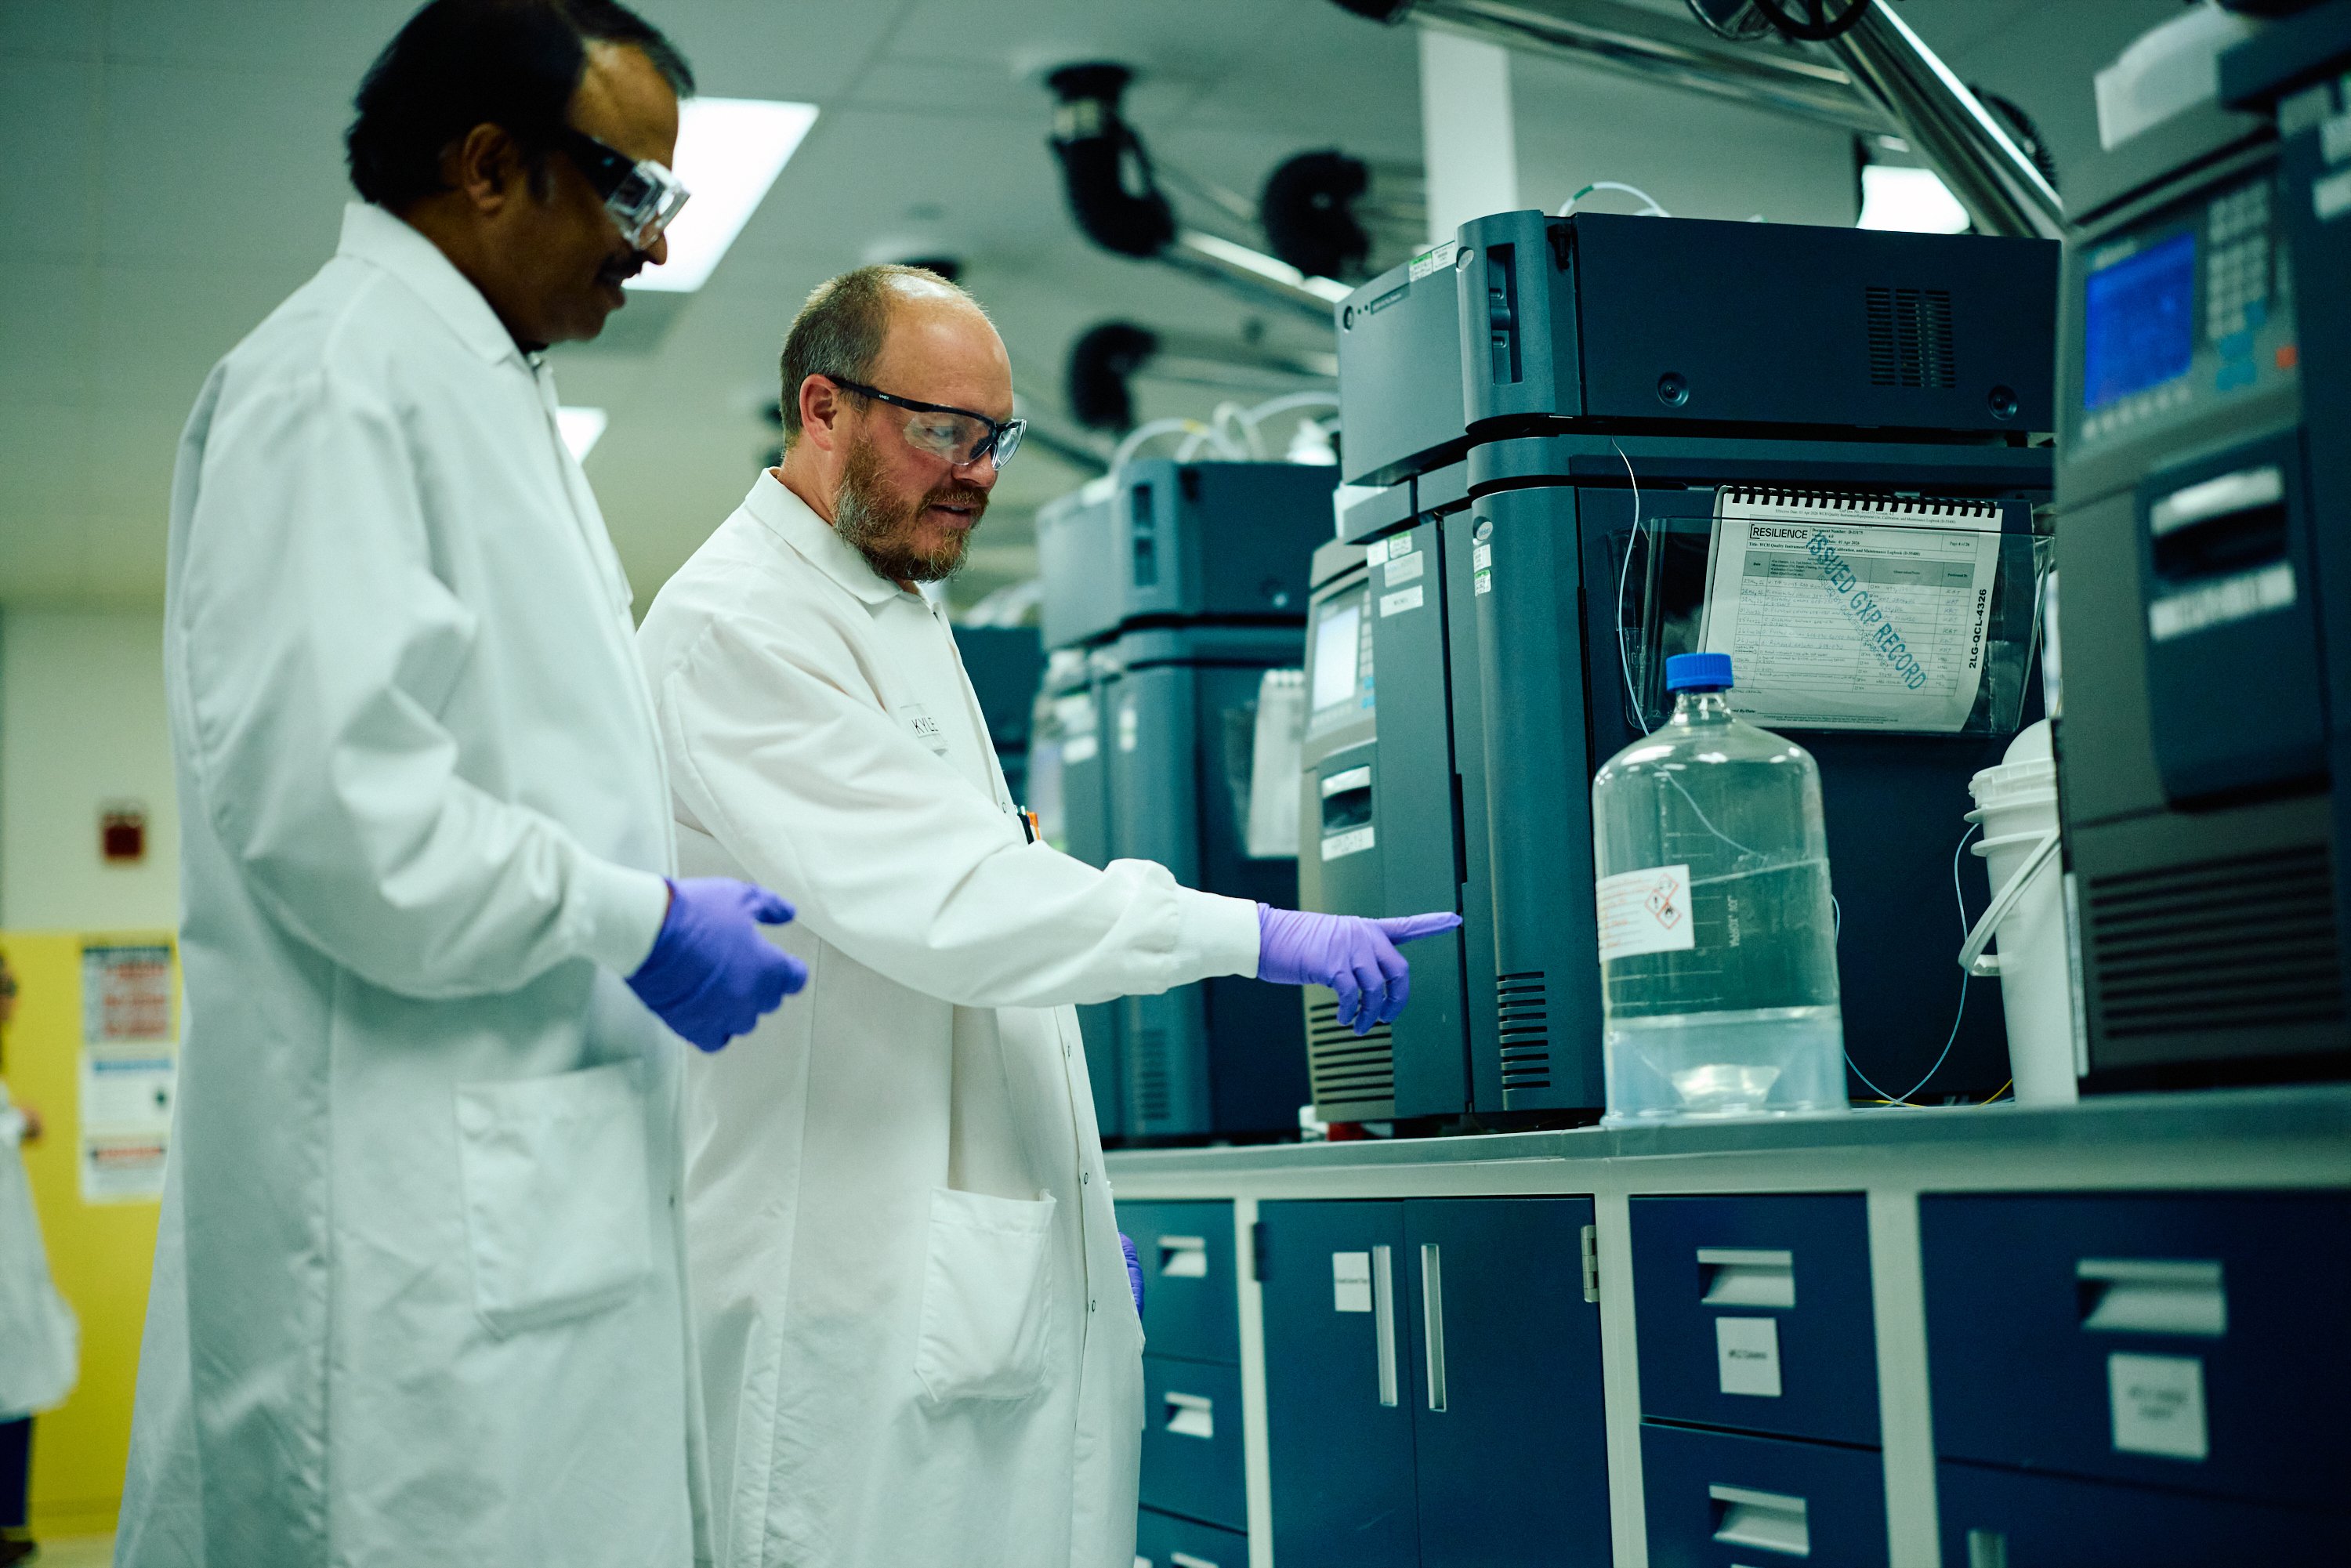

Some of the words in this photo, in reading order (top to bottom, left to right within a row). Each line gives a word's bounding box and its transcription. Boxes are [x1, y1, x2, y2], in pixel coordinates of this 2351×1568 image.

[1752, 527, 1808, 539] RESILIENCE
[1806, 530, 1857, 593] ISSUED
[1850, 591, 1882, 625] GXP
[1873, 623, 1928, 690] RECORD
[1969, 588, 1987, 669] 2LG-QCL-4326
[911, 717, 939, 734] KYLE
